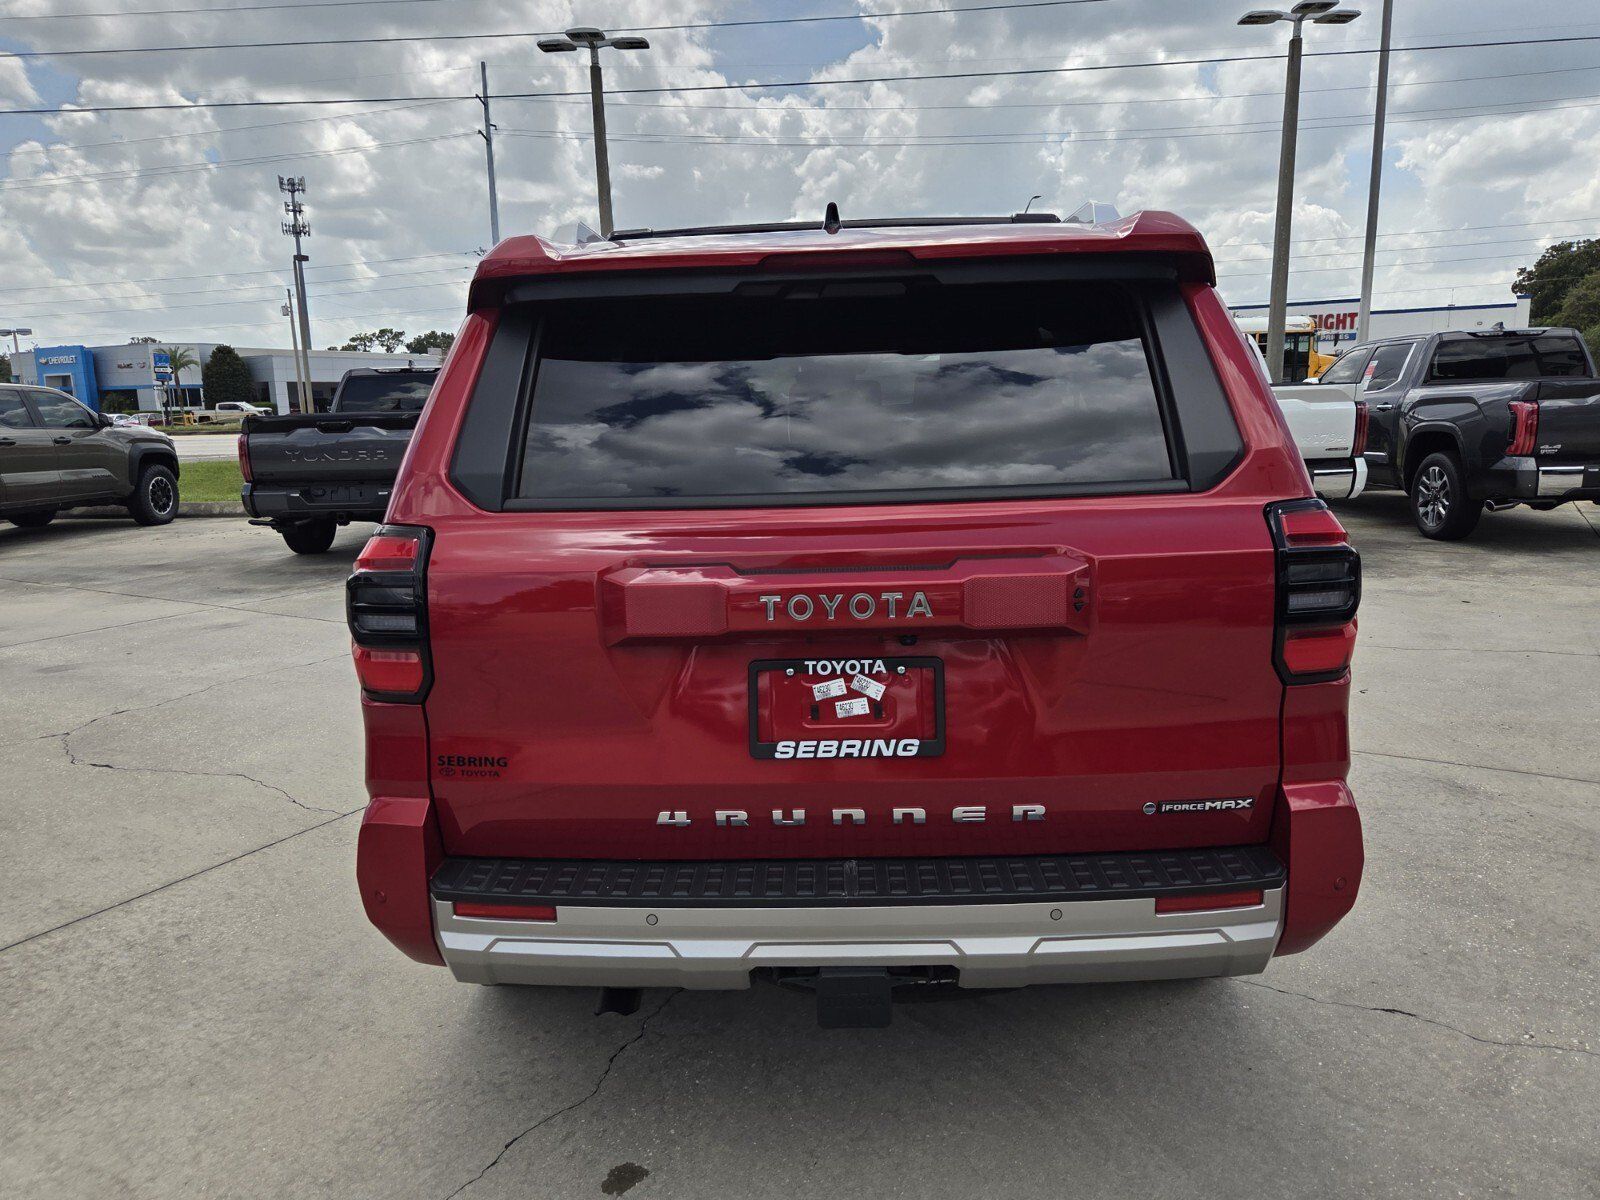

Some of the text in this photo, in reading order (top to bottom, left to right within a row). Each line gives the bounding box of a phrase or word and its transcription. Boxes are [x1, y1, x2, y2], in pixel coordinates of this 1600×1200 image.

[48, 355, 76, 365] CHEVROLET
[285, 450, 389, 461] TUNDRA
[759, 591, 934, 621] TOYOTA
[804, 659, 887, 675] TOYOTA
[774, 738, 920, 759] SEBRING
[437, 755, 508, 767] SEBRING
[461, 769, 500, 777] TOYOTA
[656, 804, 1047, 827] 4RUNNER
